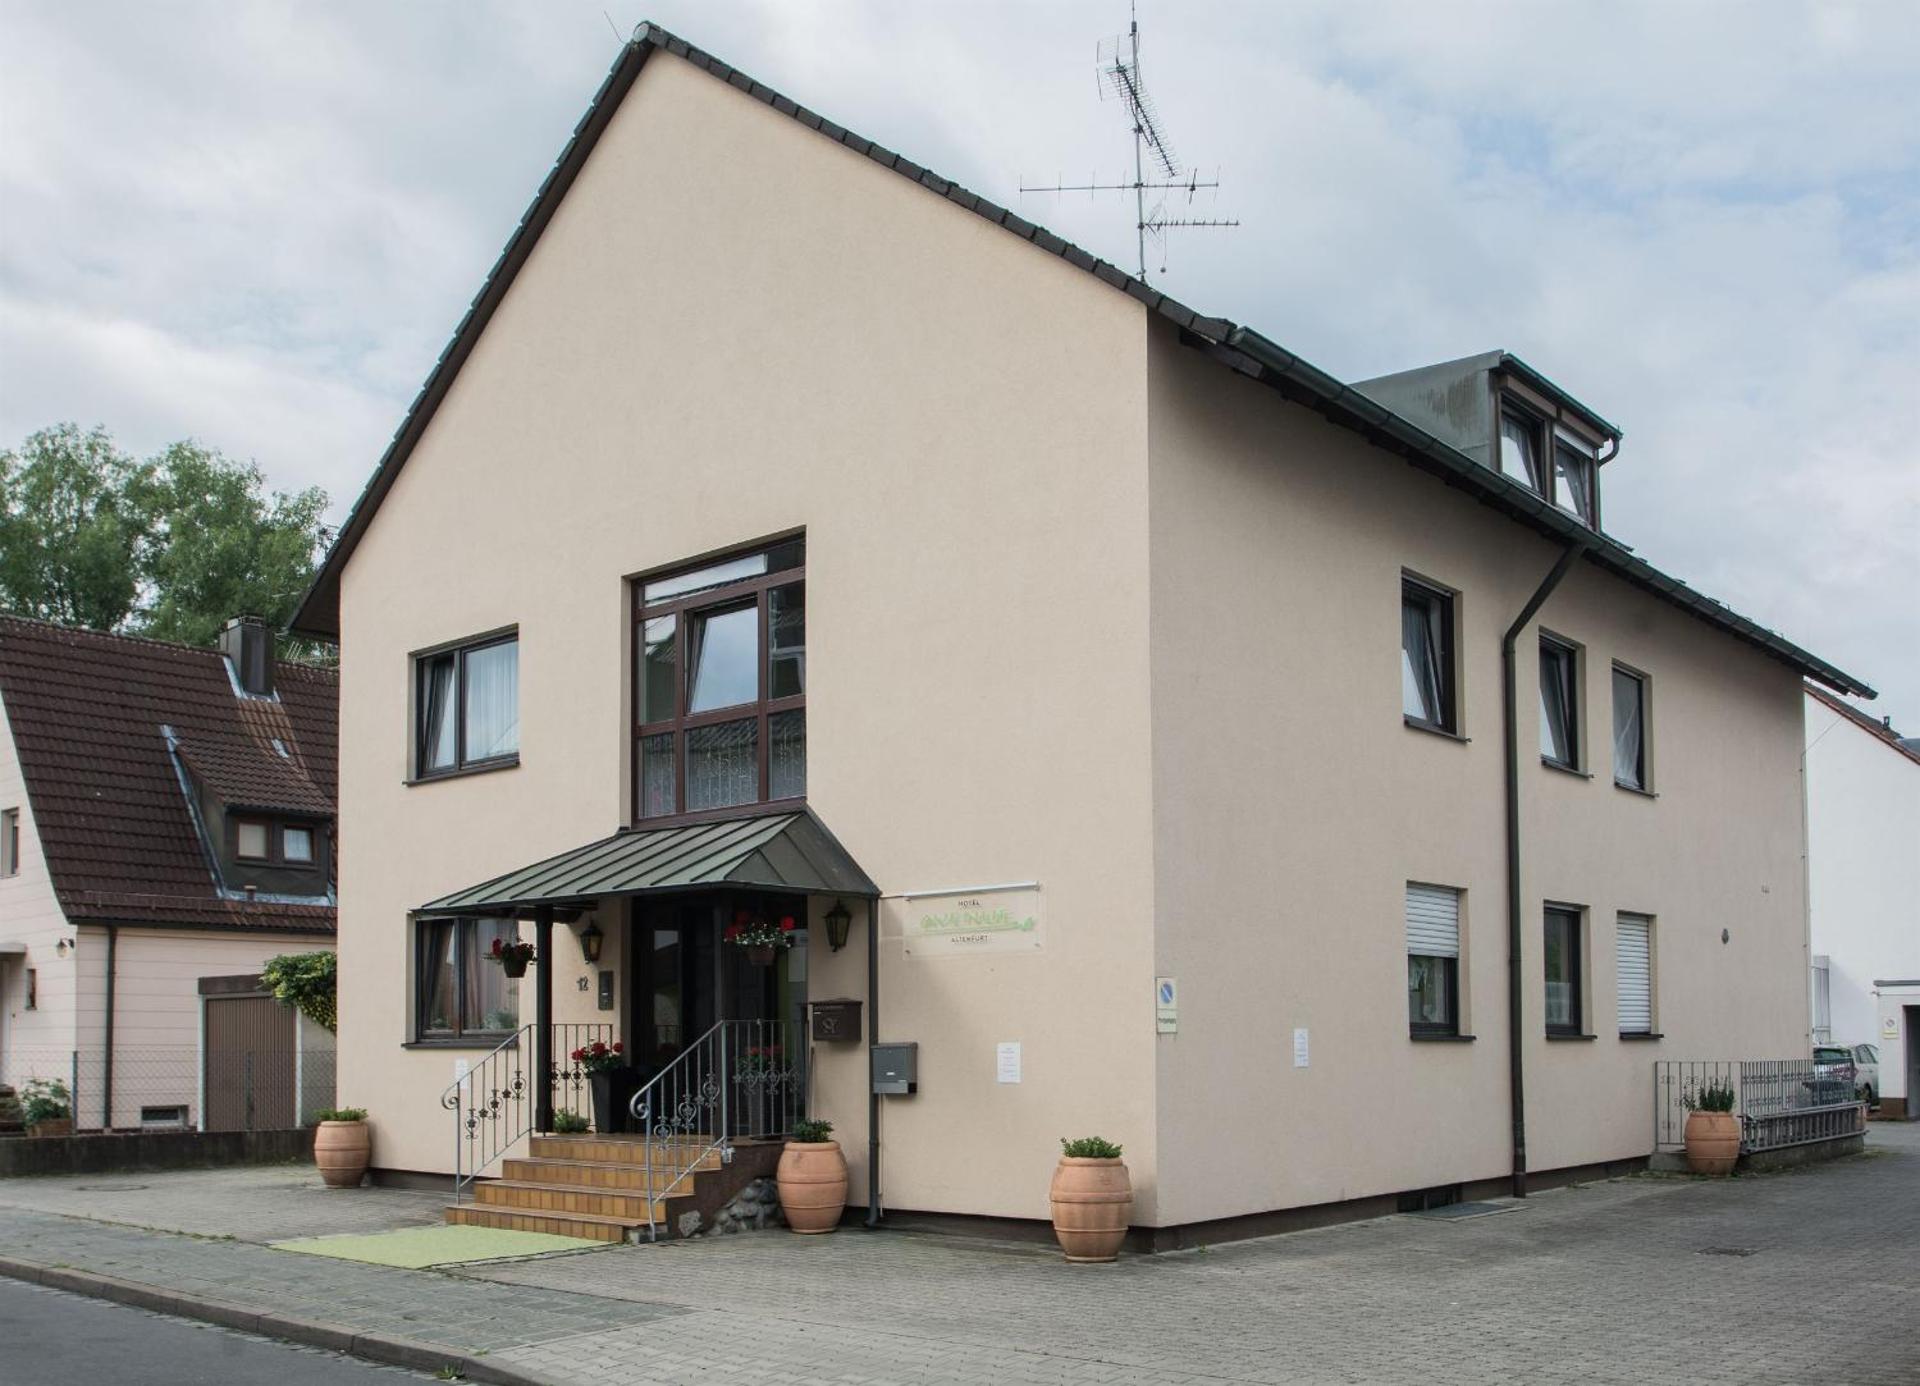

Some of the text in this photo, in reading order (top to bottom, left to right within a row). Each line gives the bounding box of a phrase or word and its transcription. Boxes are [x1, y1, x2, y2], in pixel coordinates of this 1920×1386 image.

[958, 899, 981, 908] HOTEL
[951, 935, 988, 943] ALTENFURT
[576, 976, 589, 991] 12
